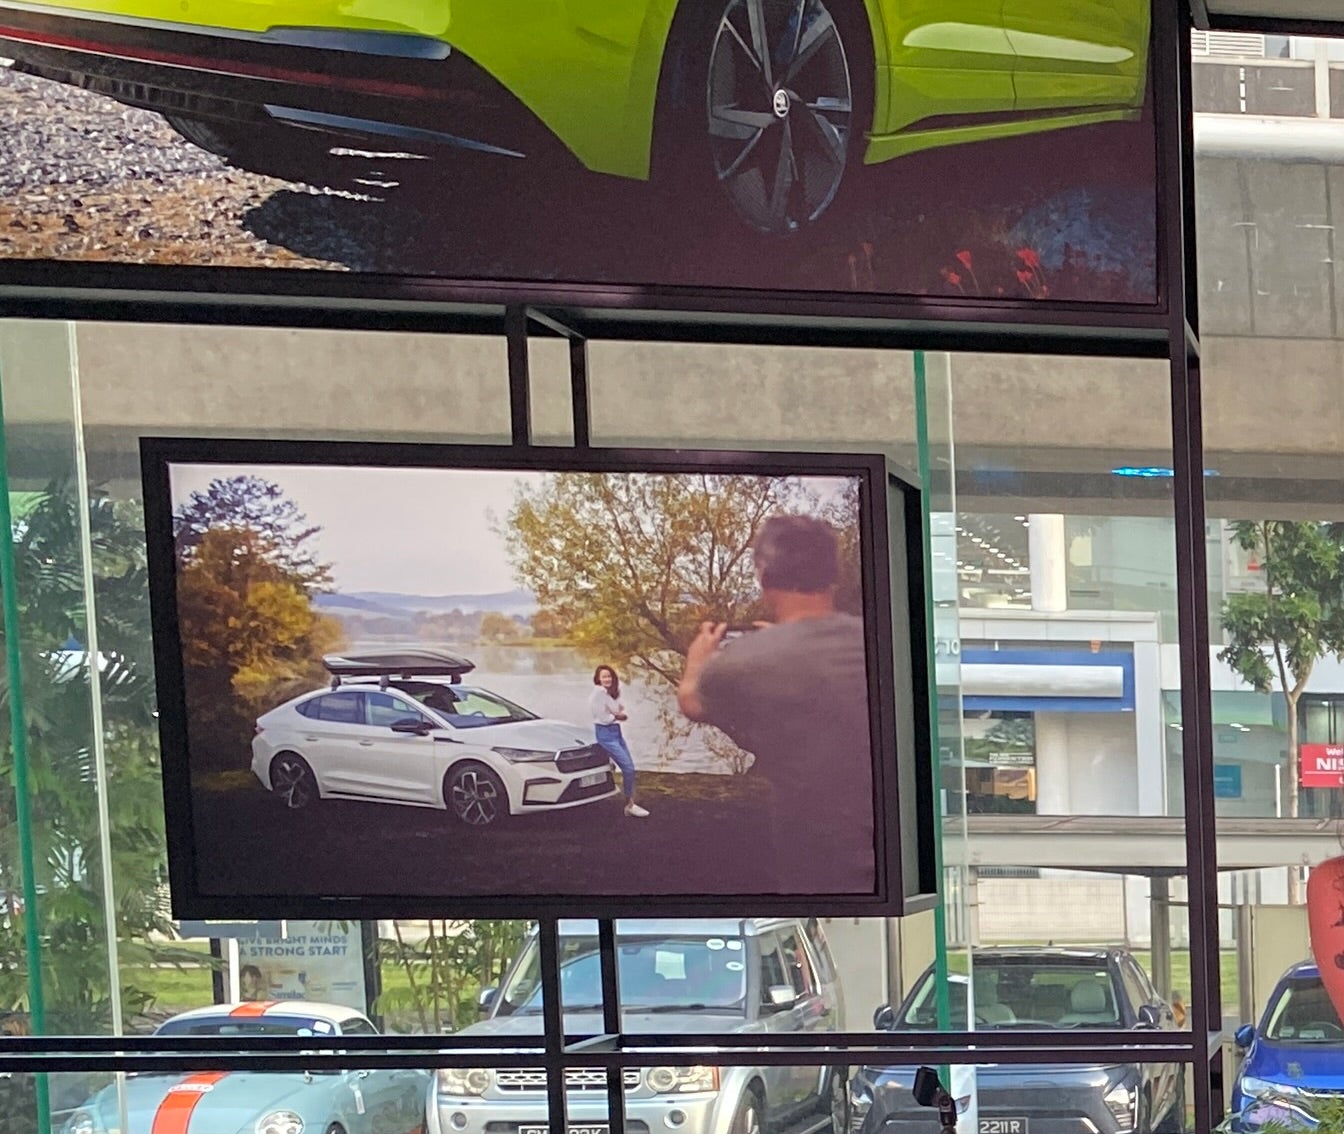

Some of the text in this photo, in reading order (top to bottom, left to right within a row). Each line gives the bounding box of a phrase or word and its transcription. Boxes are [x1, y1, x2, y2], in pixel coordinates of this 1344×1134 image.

[265, 936, 307, 945] BRIGHT
[310, 935, 348, 944] MINDS
[250, 946, 305, 956] STRONG
[309, 946, 348, 956] START
